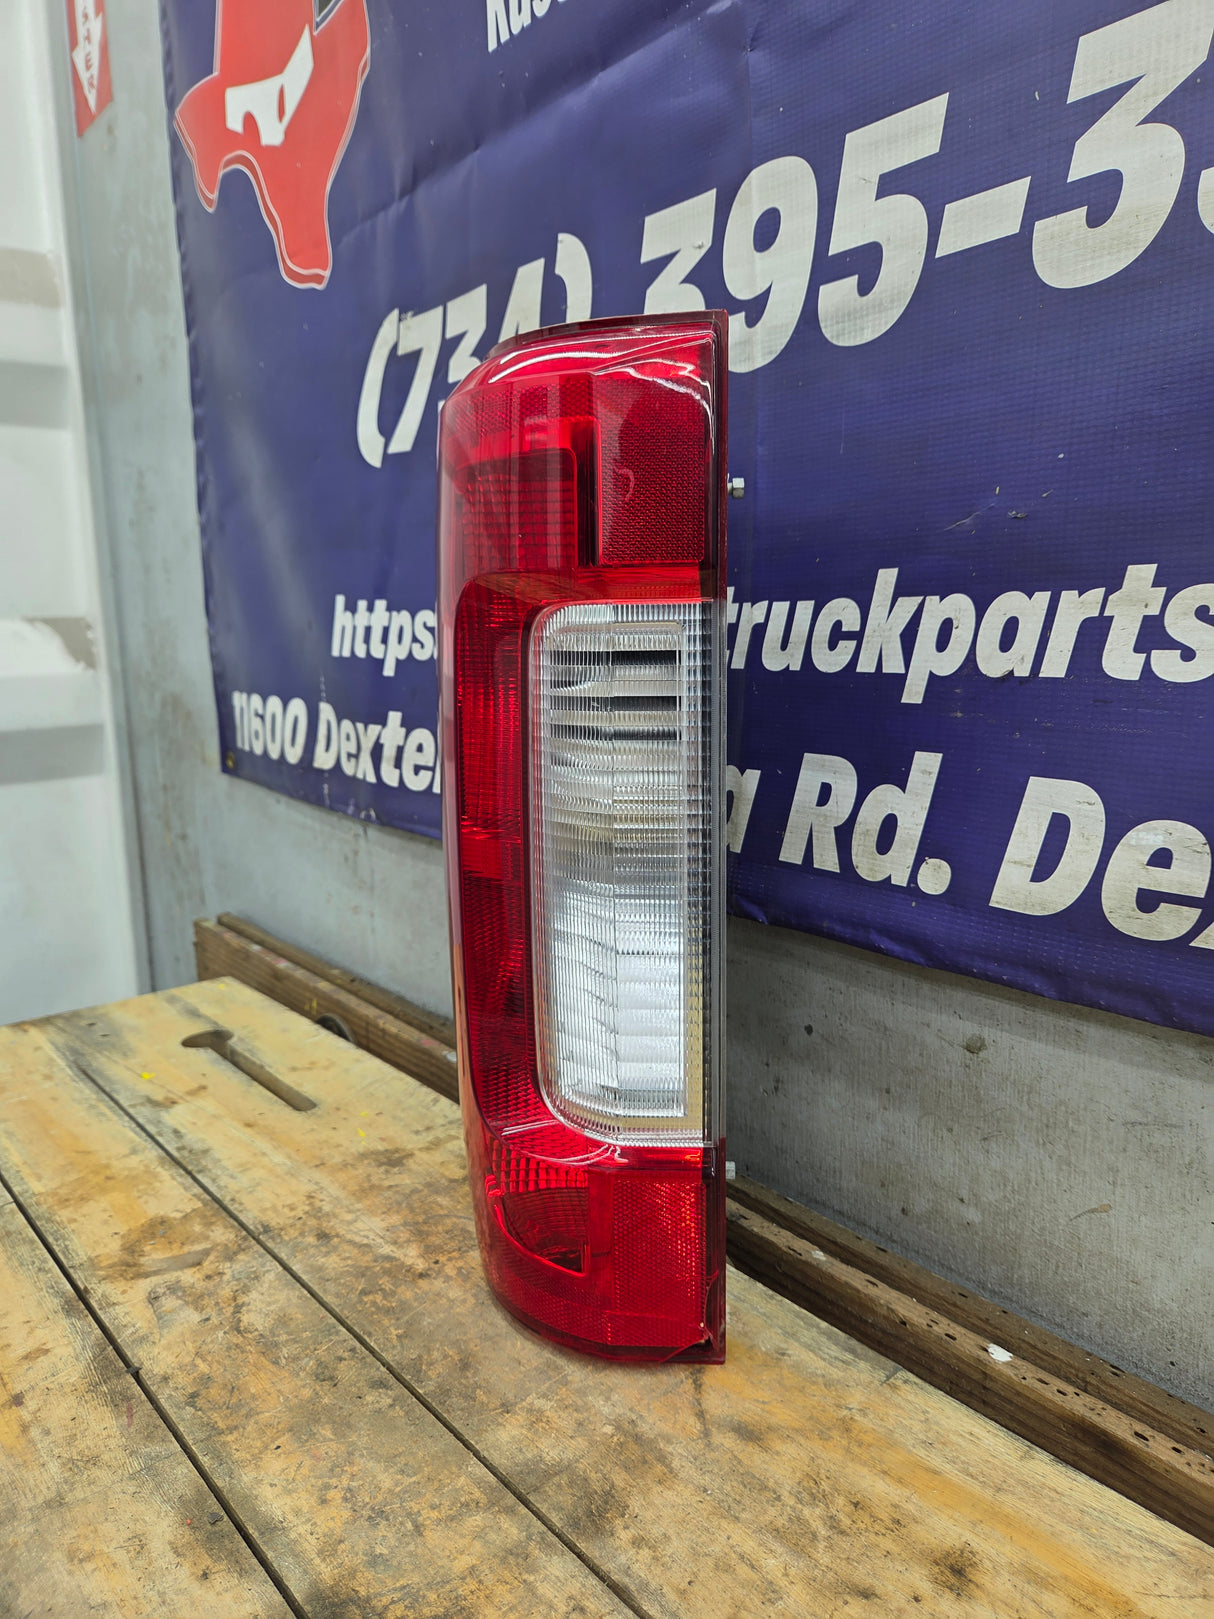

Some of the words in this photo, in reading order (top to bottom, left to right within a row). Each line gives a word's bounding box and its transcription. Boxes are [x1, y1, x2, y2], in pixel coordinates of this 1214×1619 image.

[640, 0, 1214, 373] 395-3
[331, 594, 438, 677] https
[231, 690, 308, 765] 11600
[778, 751, 952, 895] Rd.
[989, 776, 1214, 950] De
